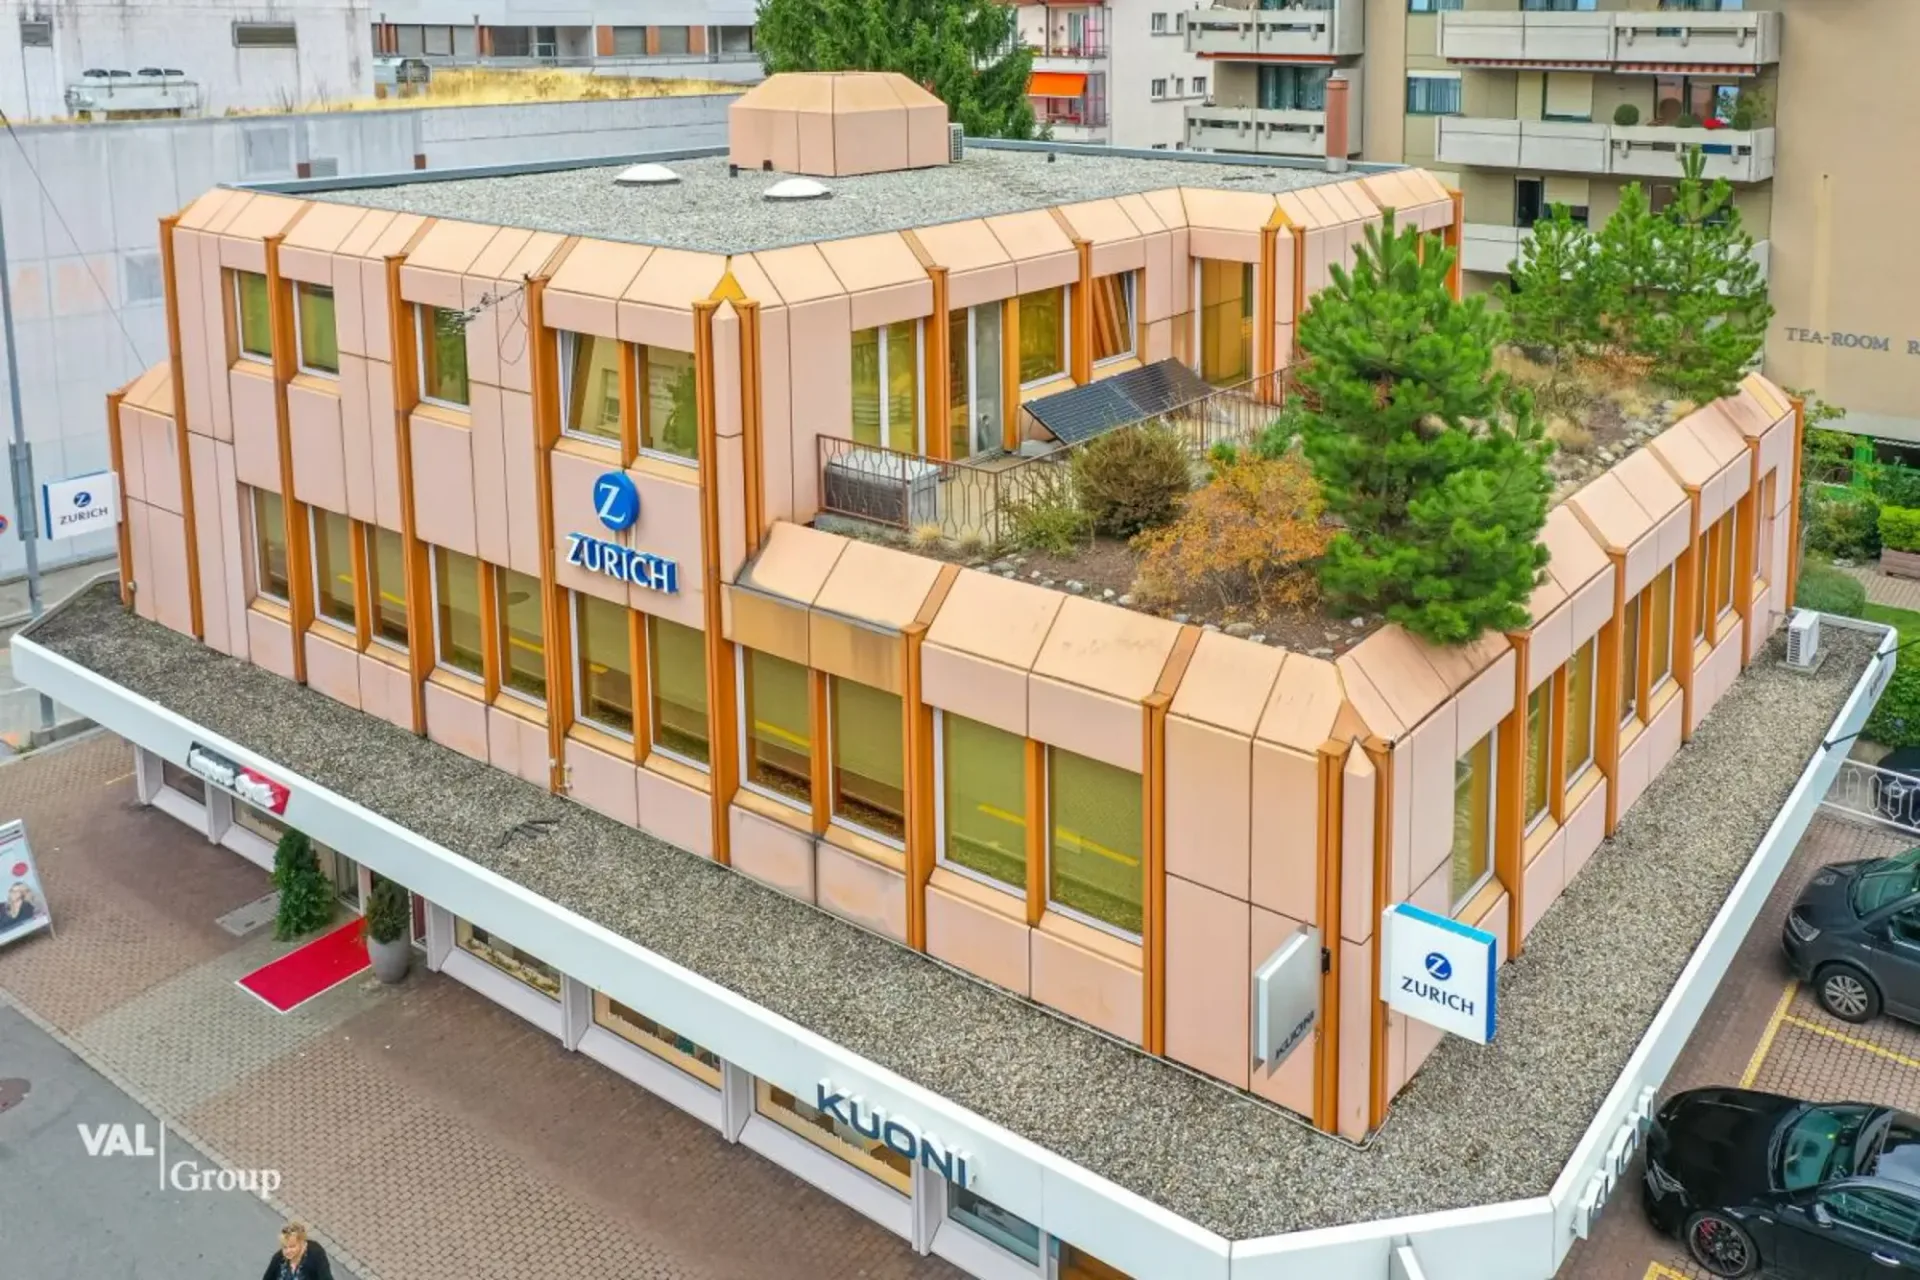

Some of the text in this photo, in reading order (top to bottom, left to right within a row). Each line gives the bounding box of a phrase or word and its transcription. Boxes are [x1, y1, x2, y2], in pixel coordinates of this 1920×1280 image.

[1784, 326, 1889, 352] TEA-ROOM
[60, 507, 108, 525] ZURICH
[598, 482, 626, 523] Z
[565, 532, 676, 595] ZURICH
[1426, 954, 1449, 979] Z
[1401, 975, 1475, 1017] ZURICH
[816, 1081, 968, 1190] KUONI
